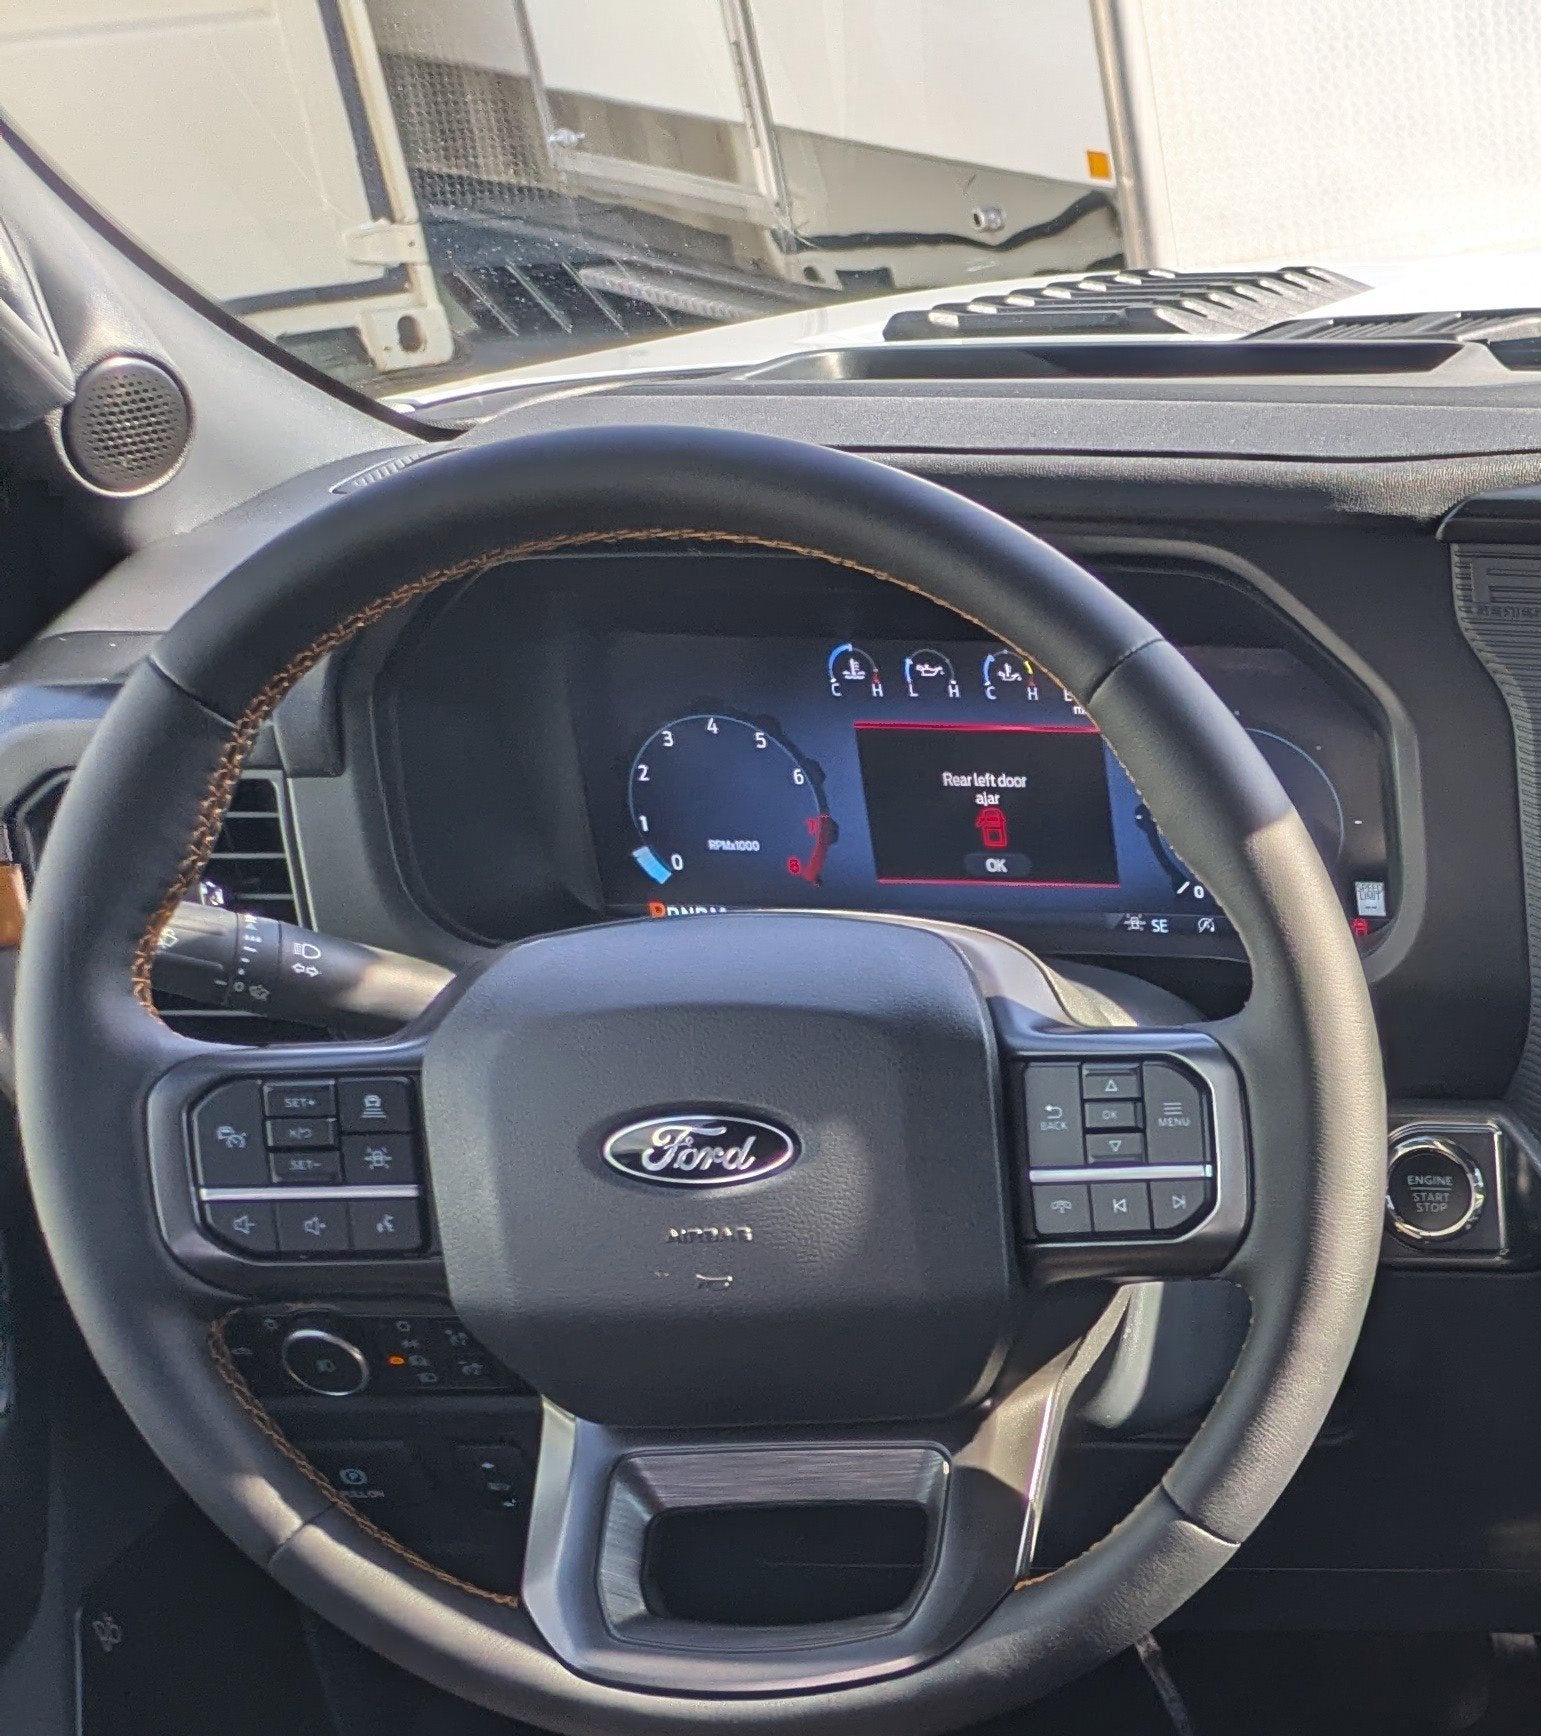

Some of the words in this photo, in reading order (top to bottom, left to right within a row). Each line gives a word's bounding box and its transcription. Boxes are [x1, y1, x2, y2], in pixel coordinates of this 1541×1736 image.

[872, 684, 884, 698] H
[948, 684, 960, 698] H
[1027, 687, 1039, 701] H
[707, 717, 719, 735] 4
[661, 730, 674, 747] 3
[754, 732, 767, 749] 5
[638, 764, 650, 781] 2
[793, 768, 805, 785] 6
[942, 771, 972, 787] Rear
[973, 772, 997, 788] left
[997, 773, 1027, 788] door
[975, 791, 1001, 806] ajar
[638, 815, 649, 832] 1
[671, 854, 684, 871] 0
[985, 858, 1008, 873] OK
[1193, 885, 1205, 899] 0
[1151, 918, 1169, 934] SE
[642, 1124, 758, 1172] Ford
[1407, 1175, 1454, 1186] ENGINE
[1412, 1192, 1450, 1202] START
[1415, 1203, 1449, 1213] STOP
